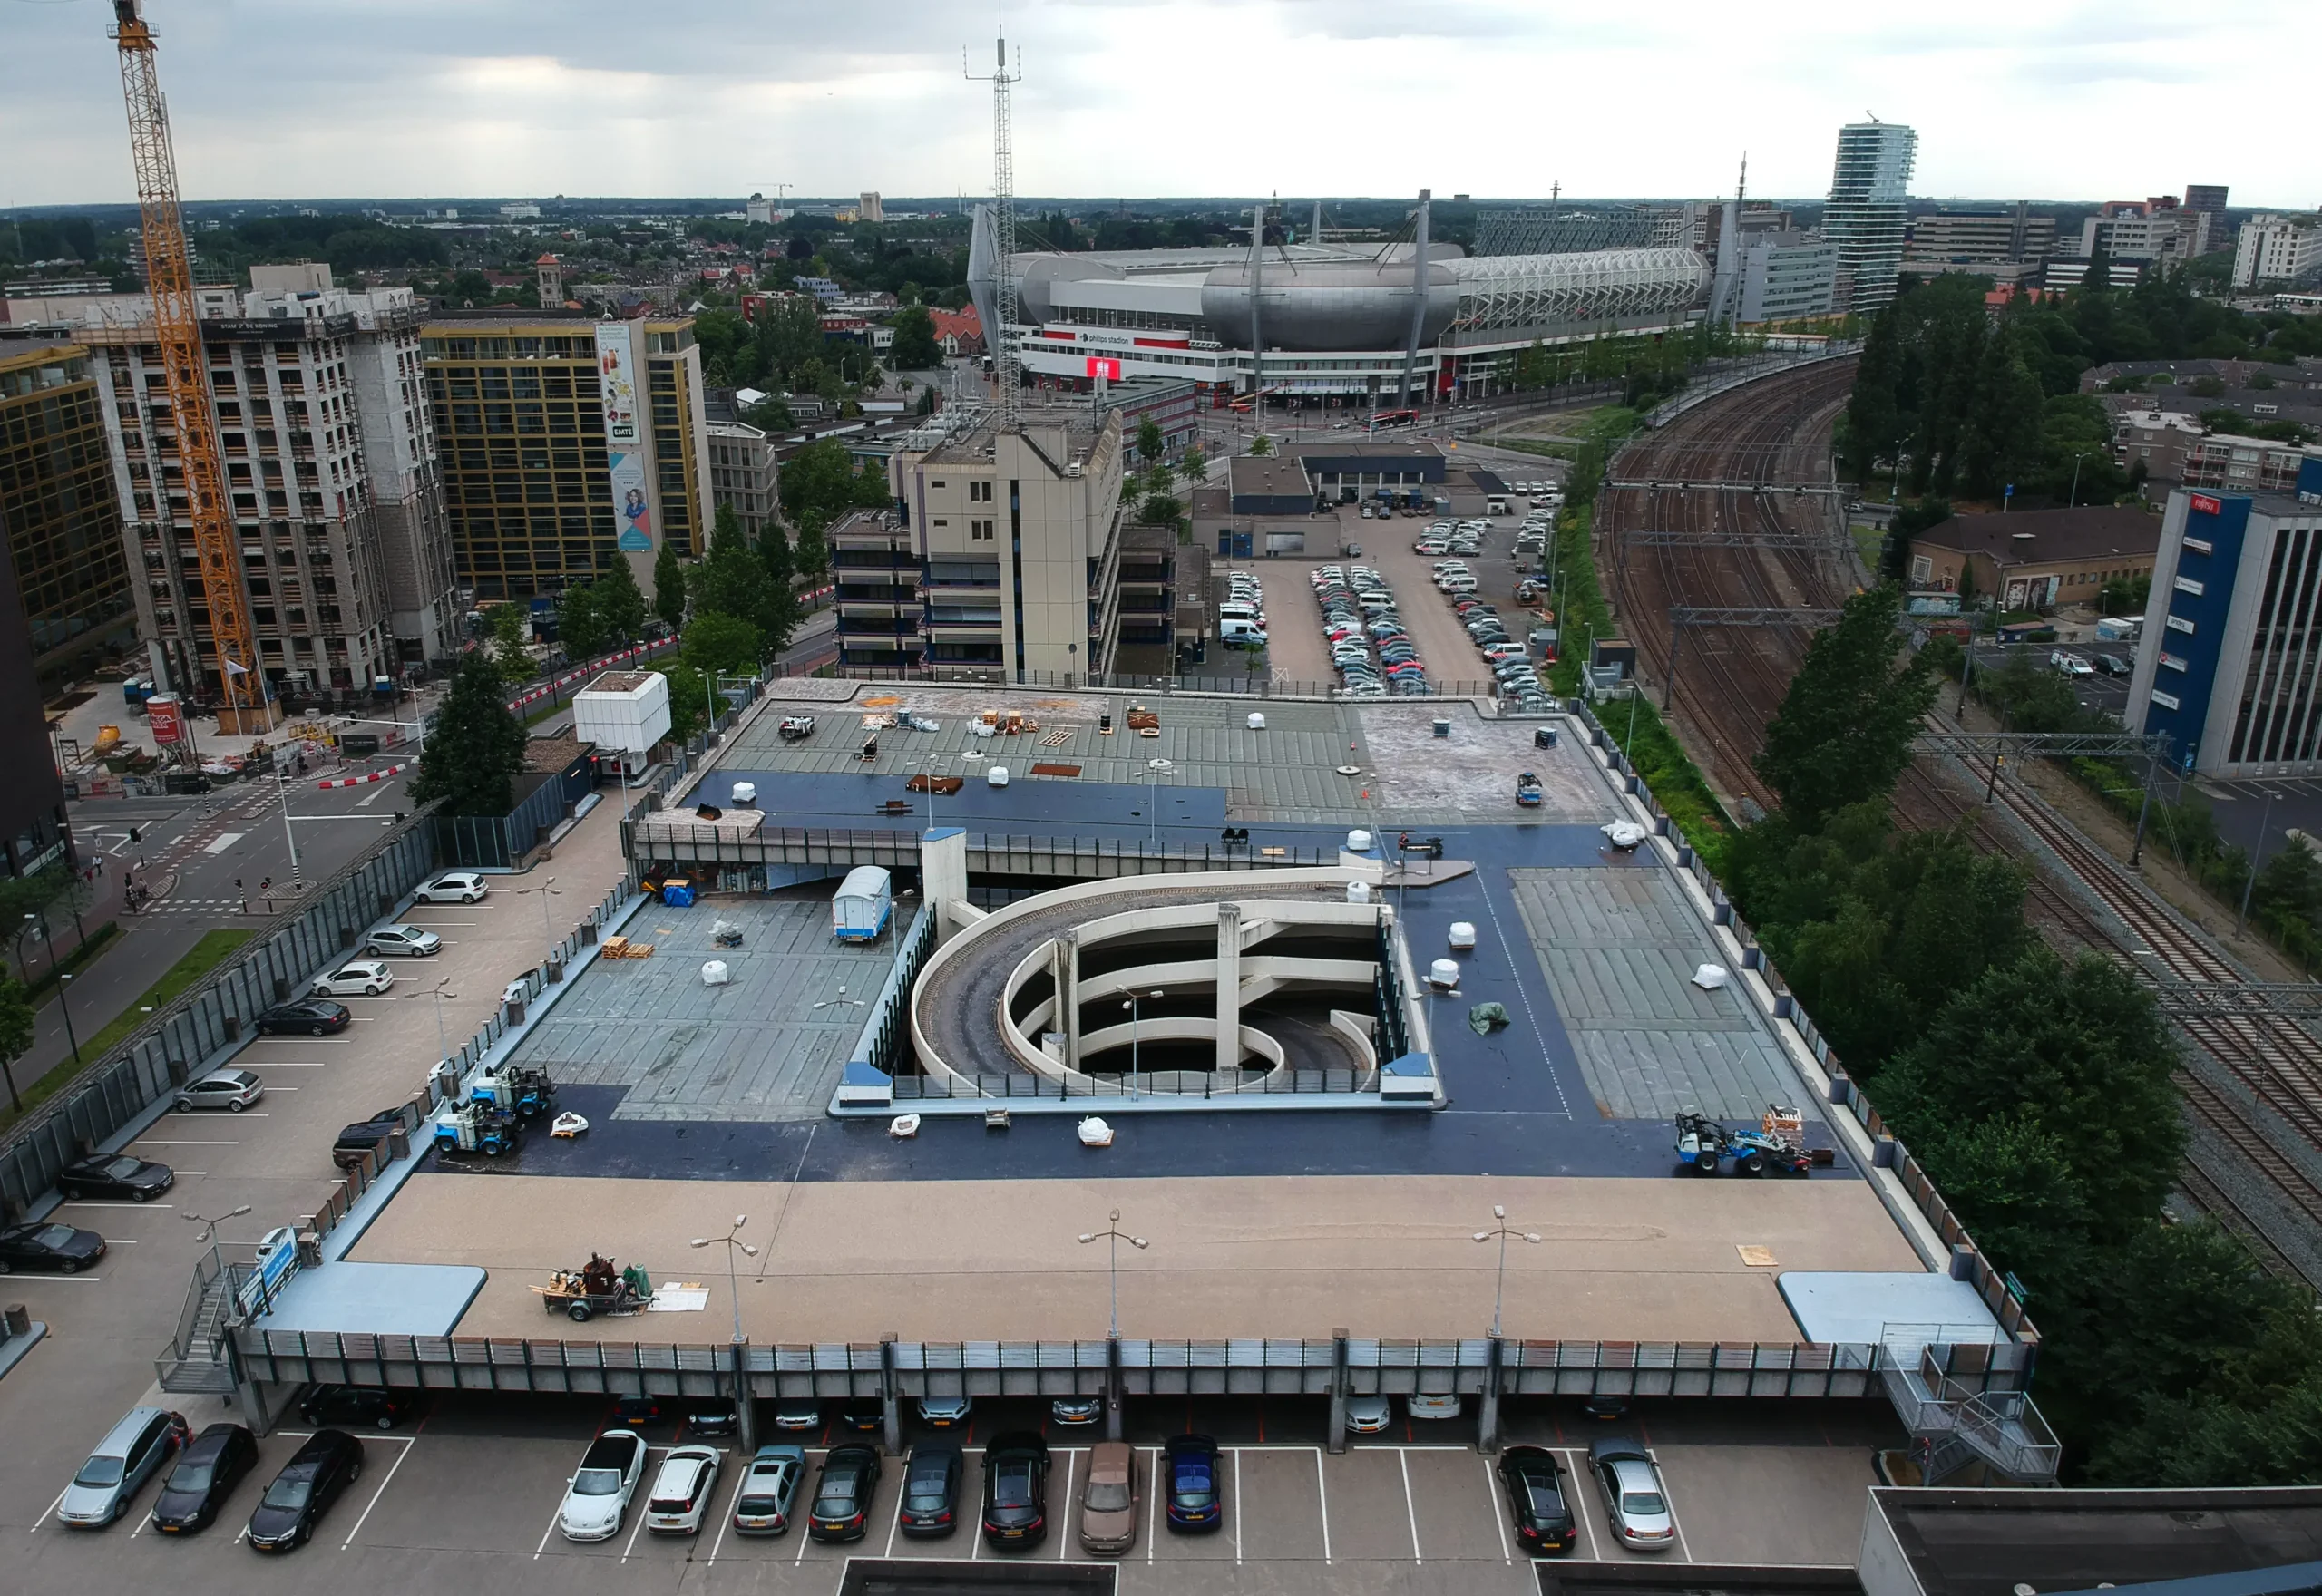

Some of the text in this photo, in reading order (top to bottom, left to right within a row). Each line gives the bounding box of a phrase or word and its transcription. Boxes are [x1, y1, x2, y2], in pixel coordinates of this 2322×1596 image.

[1089, 335, 1128, 345] philips stadion
[614, 427, 633, 436] EMTÉ
[2195, 499, 2214, 511] FUJITSU
